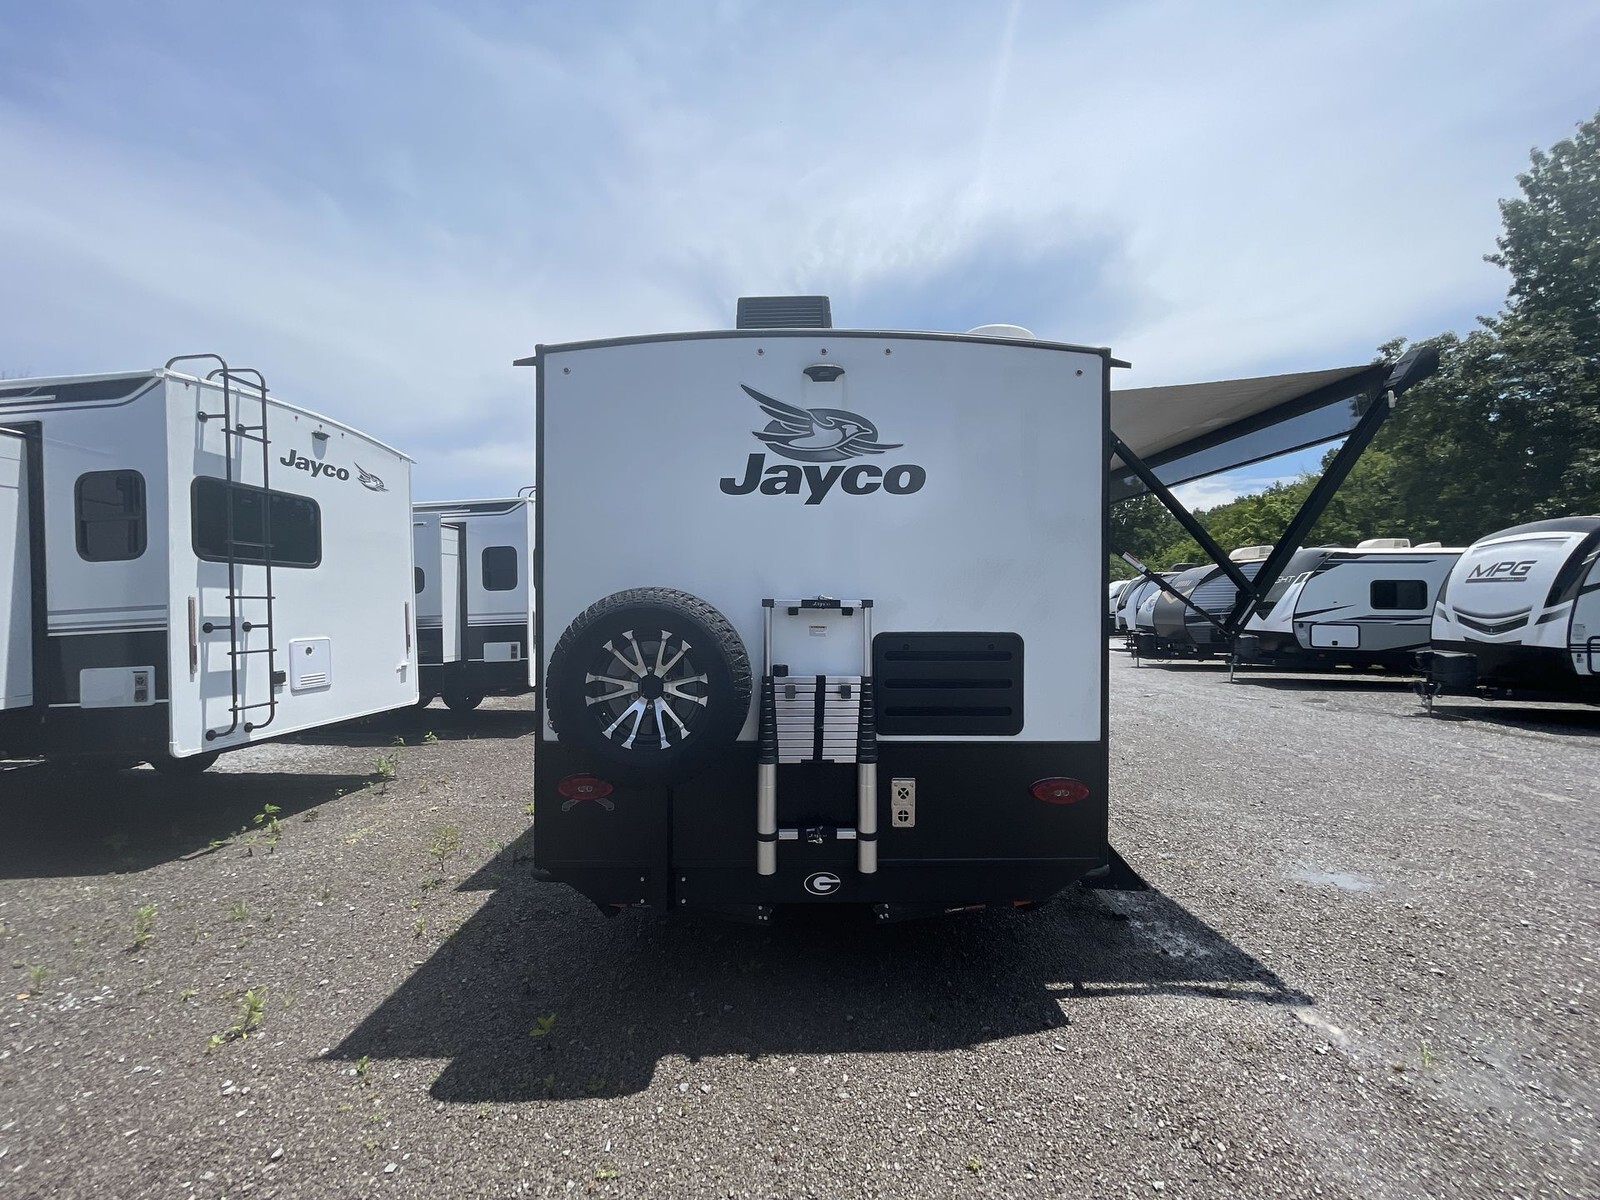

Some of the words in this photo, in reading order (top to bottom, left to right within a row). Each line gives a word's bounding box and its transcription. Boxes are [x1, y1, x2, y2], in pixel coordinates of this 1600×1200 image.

[280, 449, 349, 481] Jayco
[720, 454, 927, 504] Jayco
[1468, 560, 1538, 578] MPG
